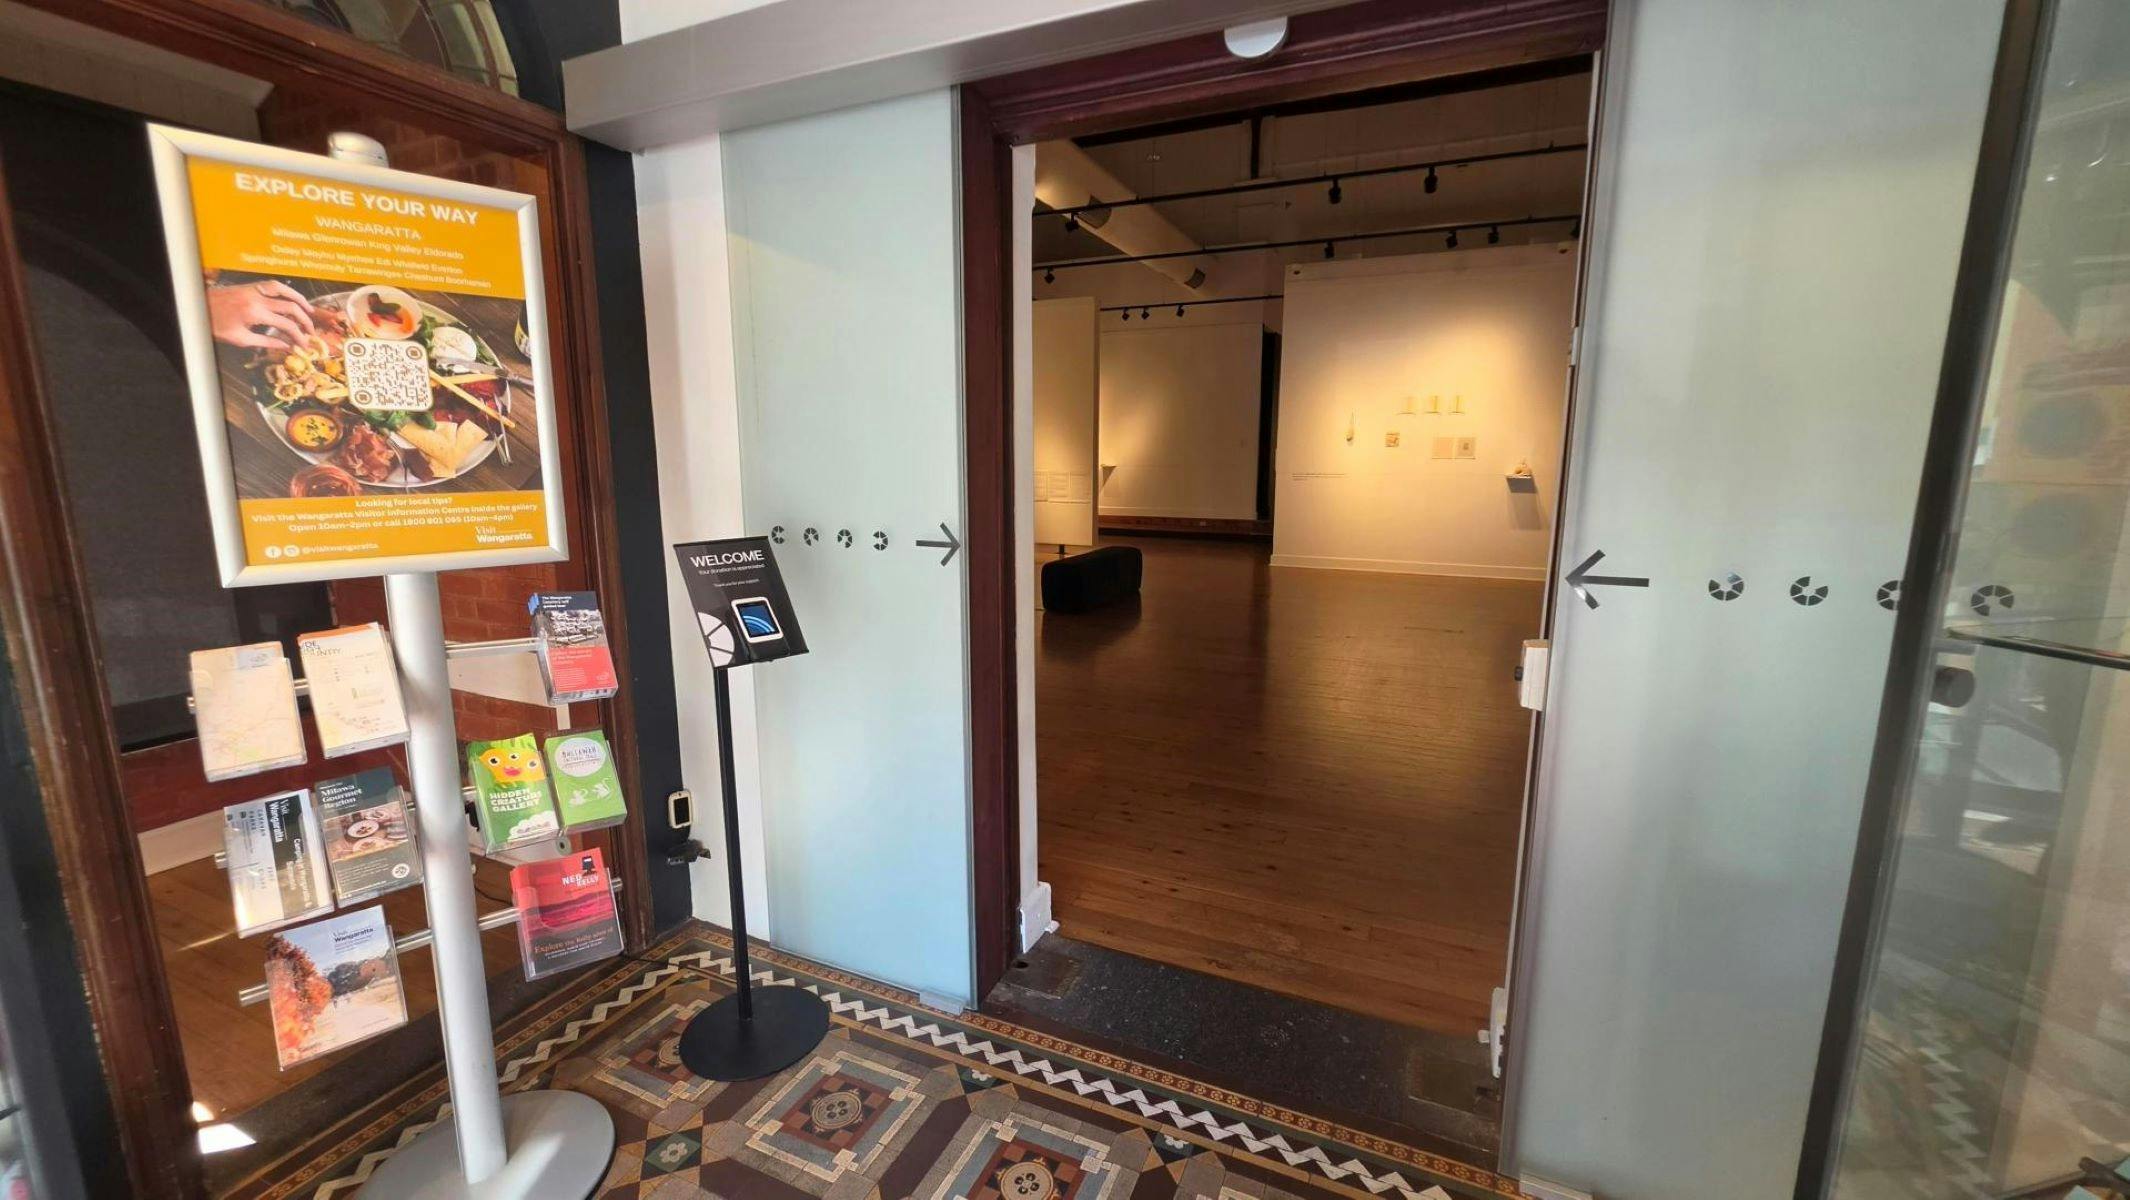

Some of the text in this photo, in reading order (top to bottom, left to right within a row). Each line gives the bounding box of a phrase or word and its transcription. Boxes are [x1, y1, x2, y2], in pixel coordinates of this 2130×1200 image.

[235, 172, 478, 225] EXPLORE YOUR WAY
[315, 216, 422, 240] WANGARATTA
[312, 233, 367, 248] Glenrowan
[369, 240, 392, 252] King
[393, 243, 421, 255] Valley
[424, 247, 464, 260] Eldorado
[355, 499, 393, 508] Looking
[408, 497, 430, 505] local
[432, 496, 452, 505] tips?
[252, 503, 537, 522] Visit the Wangaratta Visitor Information Centre inside the gallery
[288, 523, 317, 533] Open
[385, 518, 401, 527] call
[403, 517, 426, 527] 1800
[475, 525, 496, 534] Visit
[476, 532, 533, 543] Wangaratta
[690, 549, 765, 568] WELCOME
[320, 784, 355, 797] Milawa
[322, 788, 362, 803] Gourmet
[489, 788, 531, 800] HIDDEN
[280, 799, 289, 815] Visit
[323, 797, 357, 810] Region
[492, 800, 539, 812] GALLERY
[269, 802, 284, 843] Wangaratta
[561, 873, 583, 886] NED
[576, 874, 599, 887] KELLY
[334, 927, 373, 943] Wangaratta
[535, 941, 563, 954] Explore
